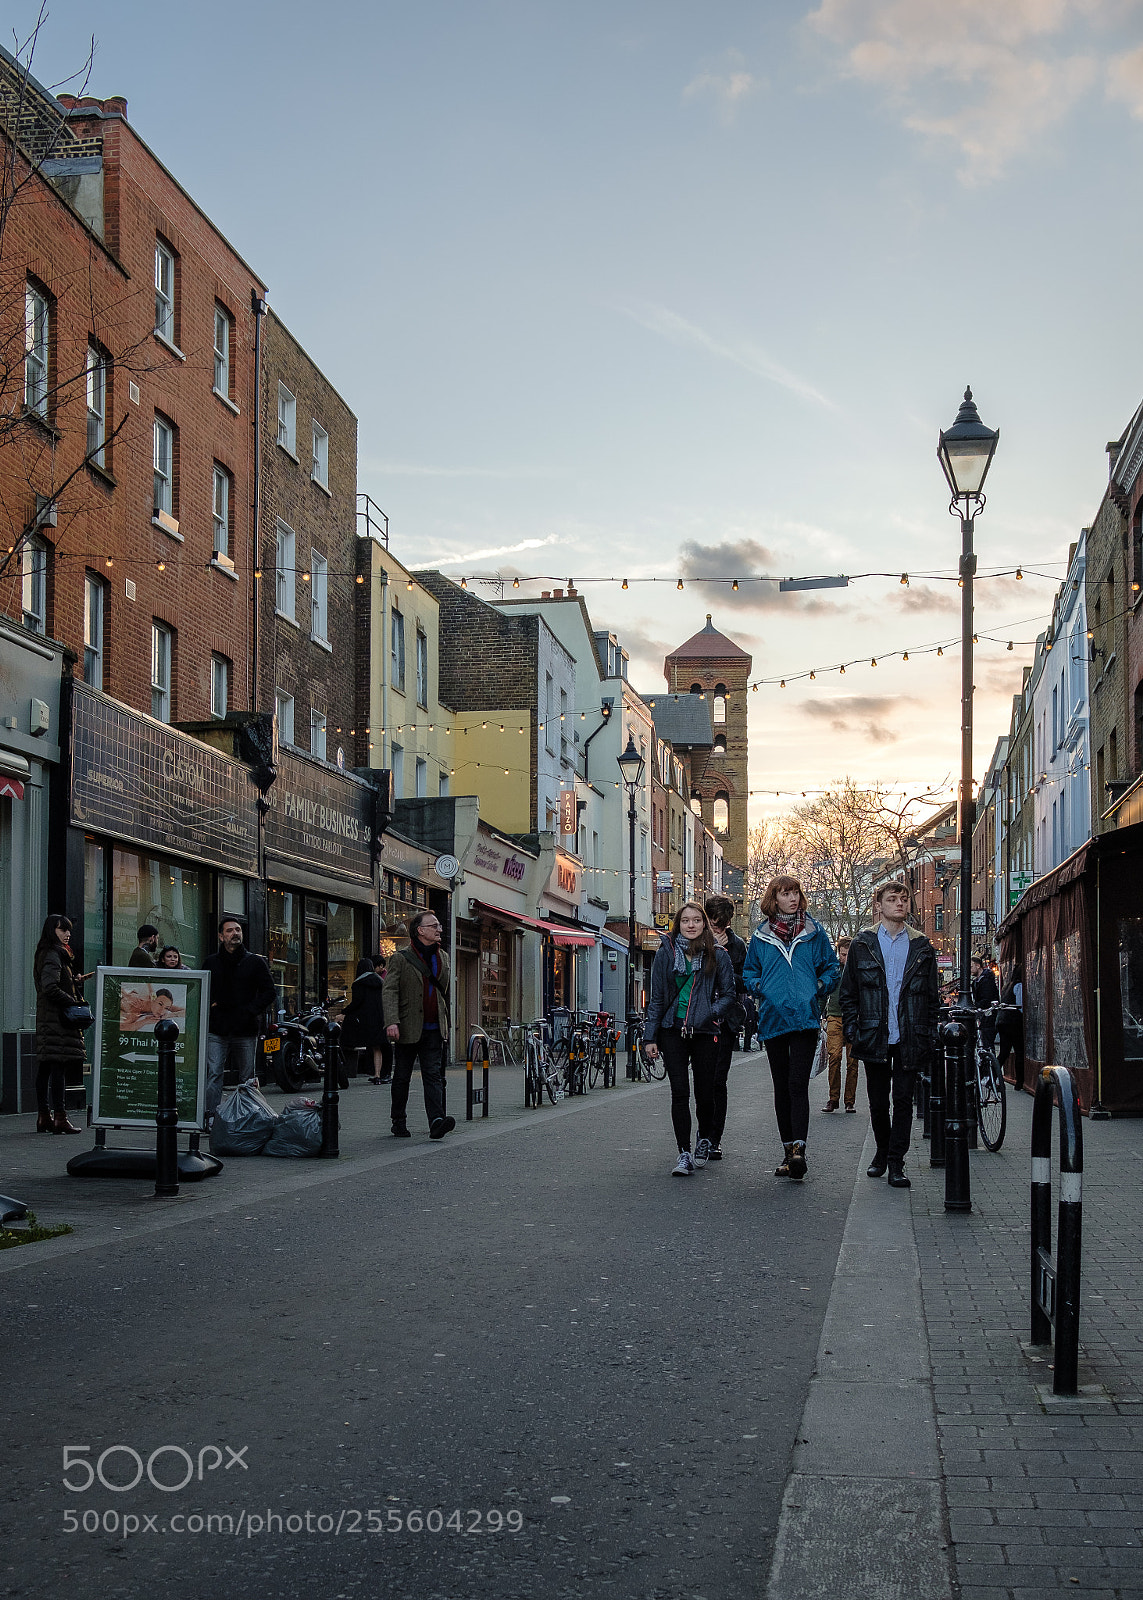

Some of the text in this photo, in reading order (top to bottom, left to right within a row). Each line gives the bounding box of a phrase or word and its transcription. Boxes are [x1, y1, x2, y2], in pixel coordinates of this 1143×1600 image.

[87, 769, 124, 793] SUPERIOR
[163, 750, 204, 793] CUSTOM
[285, 791, 318, 826] FAMILY
[319, 804, 360, 841] BUSINESS
[564, 793, 572, 831] PANZO
[226, 821, 248, 838] QUALITY
[118, 1036, 129, 1046] 99
[130, 1037, 148, 1047] Thai
